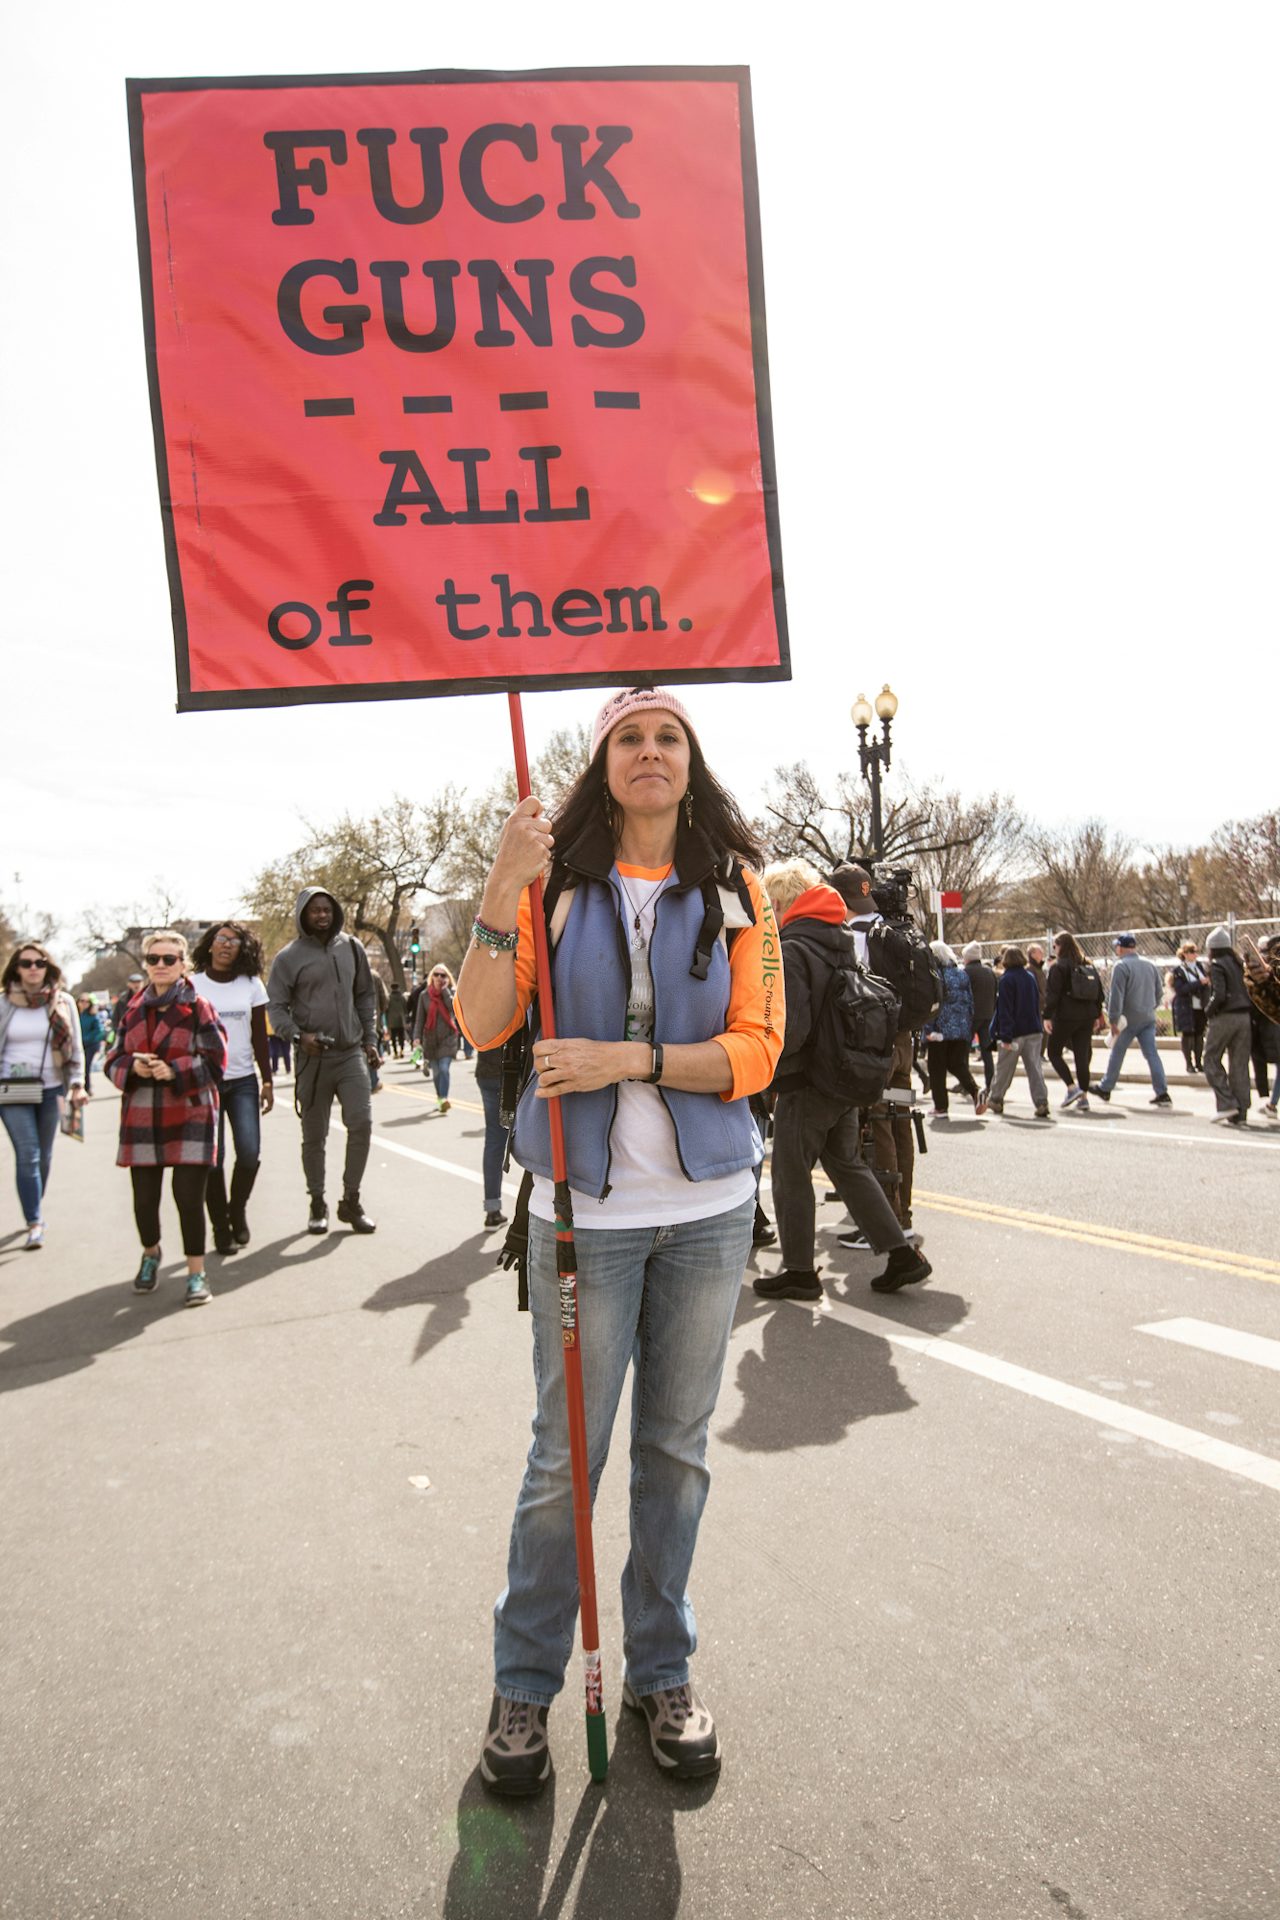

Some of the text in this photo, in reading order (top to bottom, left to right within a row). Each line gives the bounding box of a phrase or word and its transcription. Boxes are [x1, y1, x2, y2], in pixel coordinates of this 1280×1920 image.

[263, 123, 640, 226] FUCK
[277, 256, 645, 355] GUNS
[373, 446, 590, 526] ALL
[268, 574, 692, 650] of them.
[763, 990, 774, 1039] Foundton
